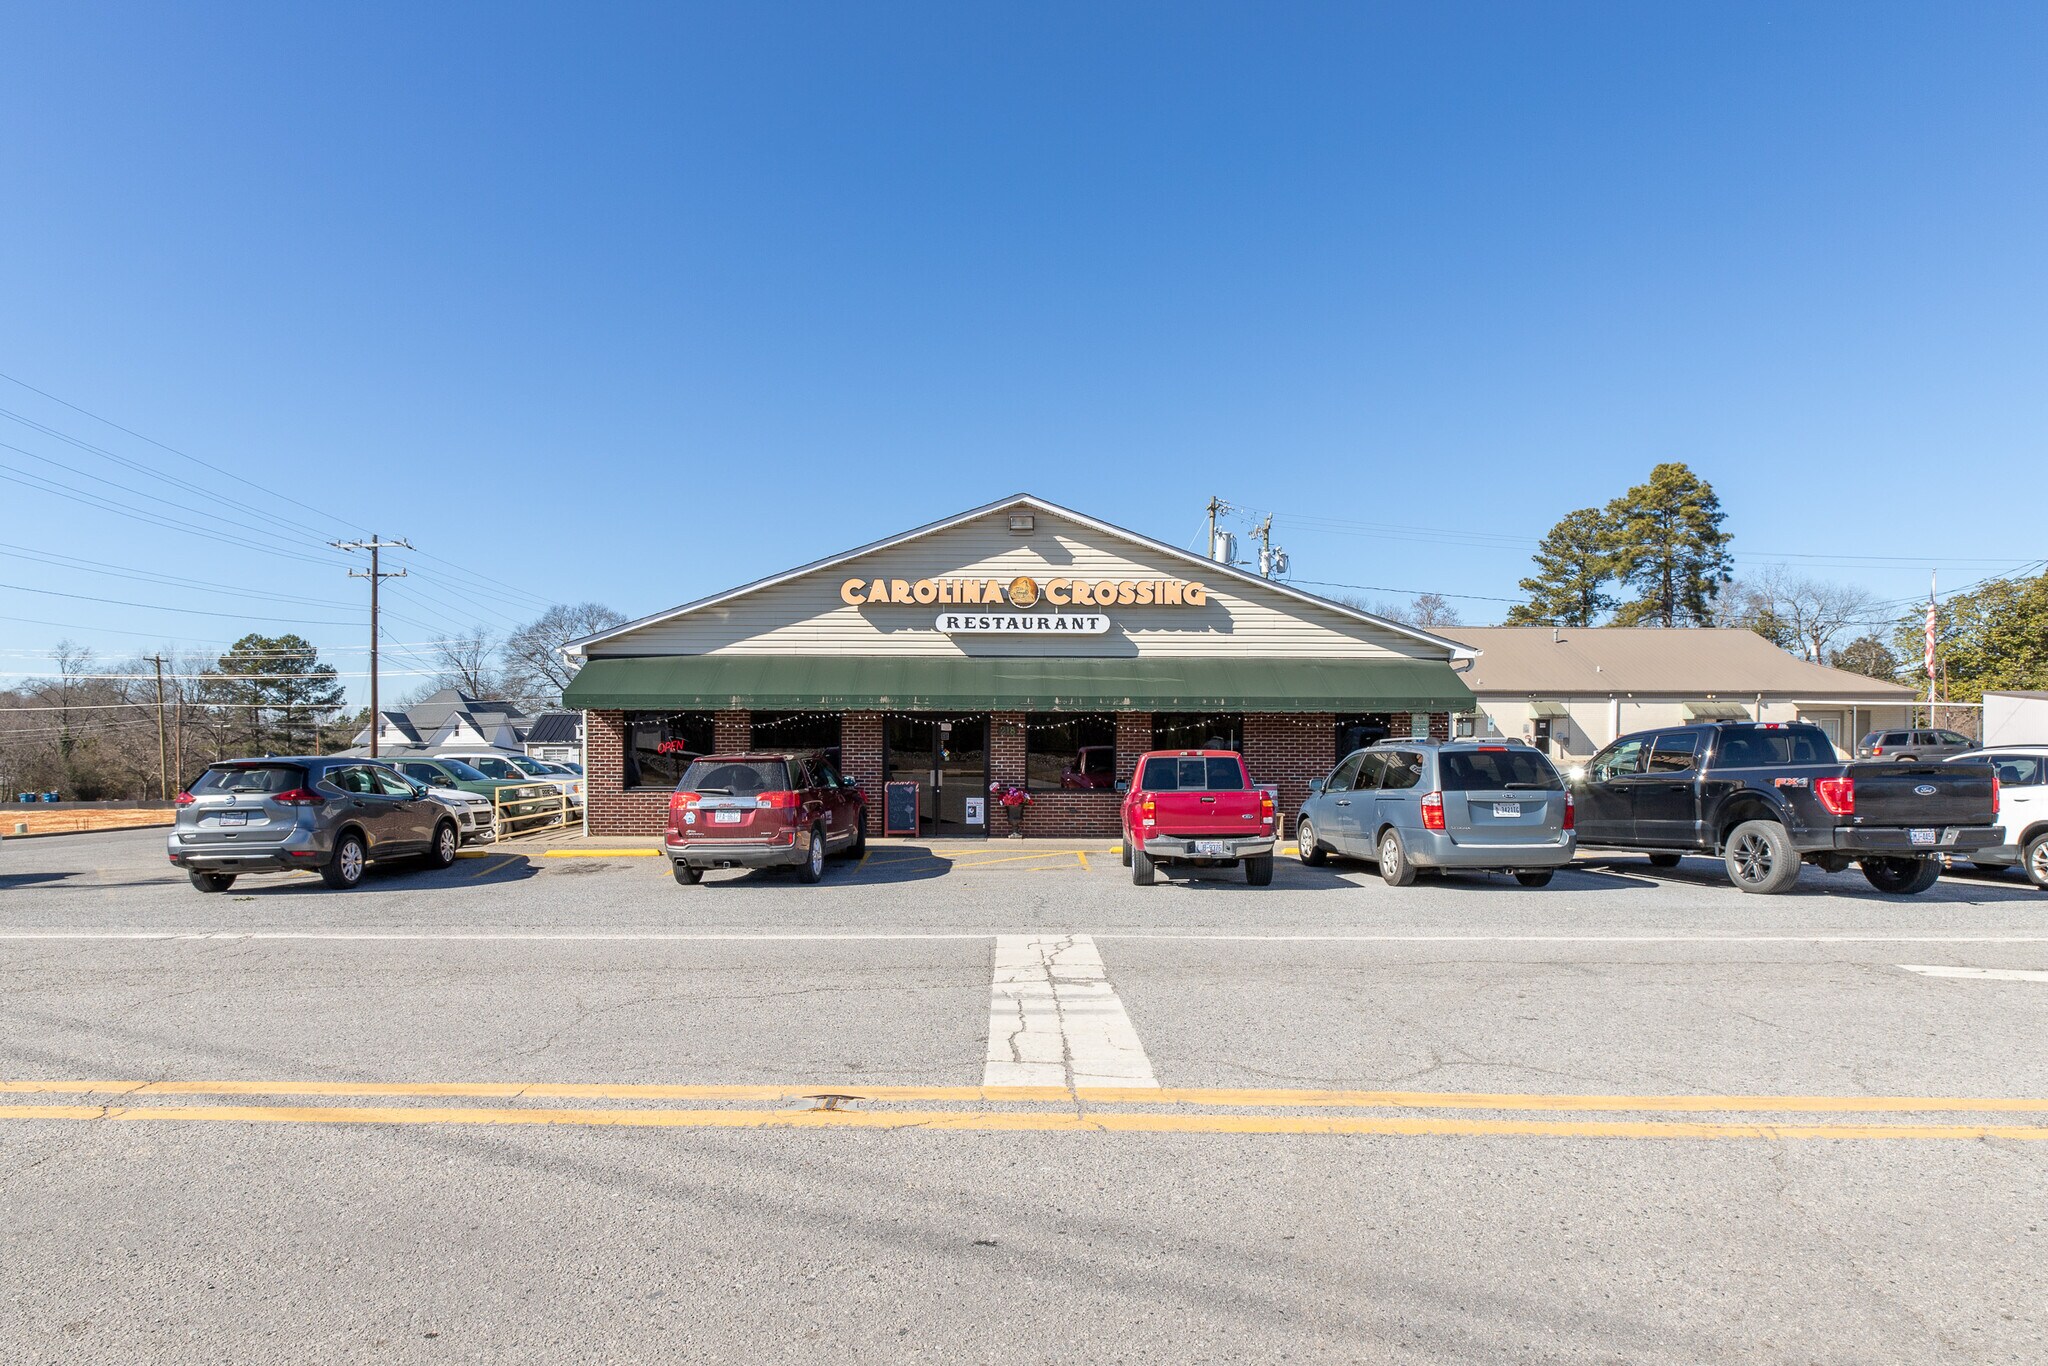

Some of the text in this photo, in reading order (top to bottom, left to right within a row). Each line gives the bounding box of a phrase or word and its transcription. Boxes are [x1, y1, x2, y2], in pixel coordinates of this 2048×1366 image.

[840, 578, 1207, 606] CAROLINA CROSSING
[946, 616, 1100, 630] RESTAURANT
[1000, 726, 1016, 735] 218
[657, 739, 685, 754] OPEN
[1774, 777, 1808, 788] FX4
